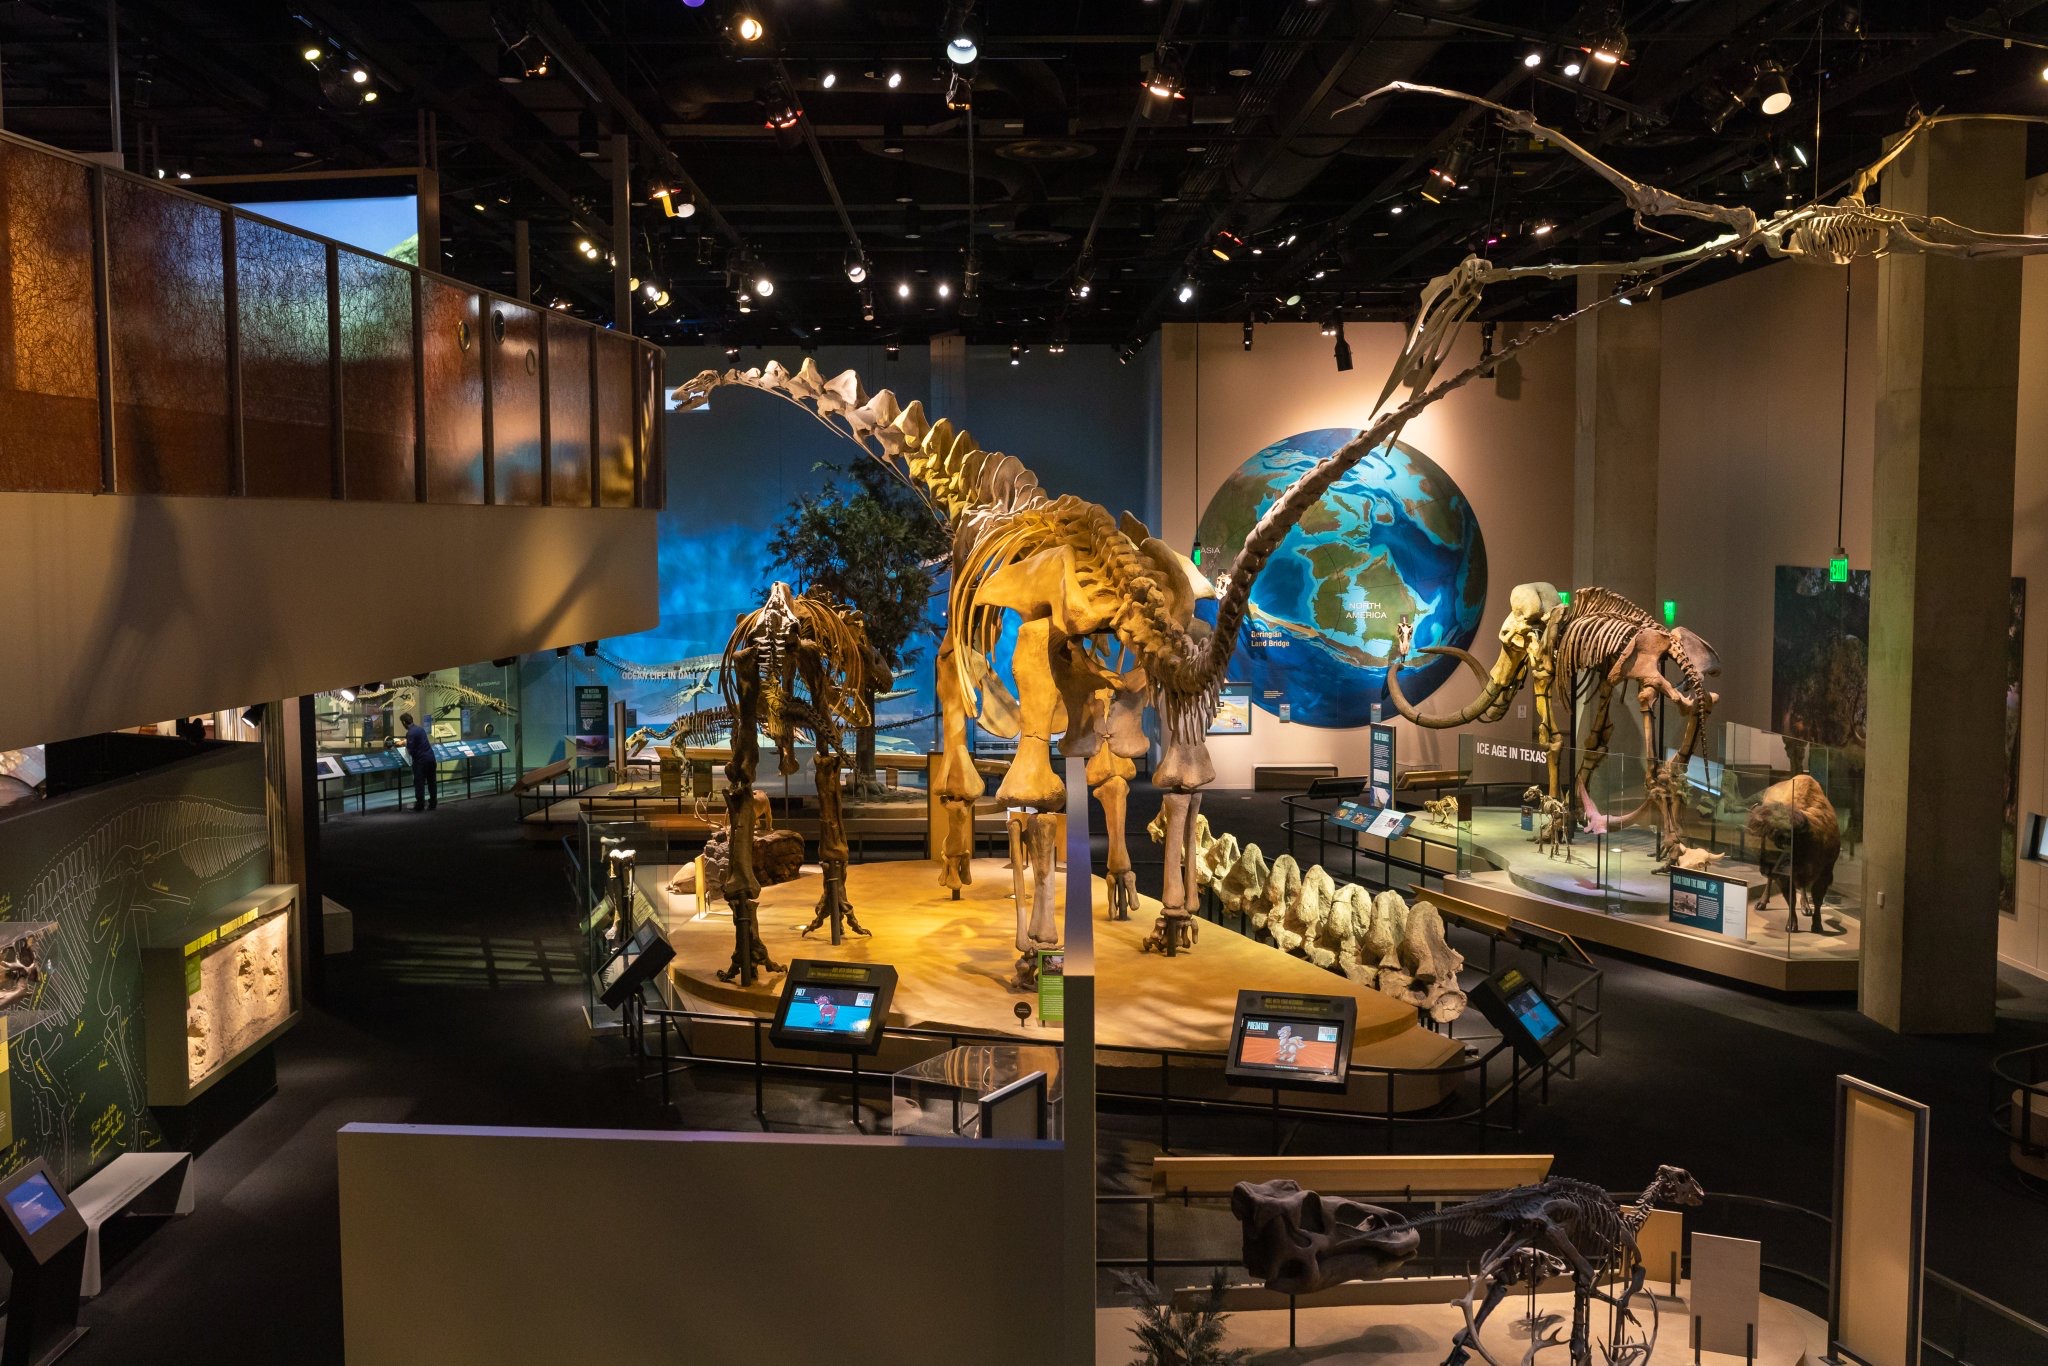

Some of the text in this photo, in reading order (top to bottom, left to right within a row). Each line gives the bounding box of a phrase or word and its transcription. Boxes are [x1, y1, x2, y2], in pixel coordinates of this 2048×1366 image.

[1200, 546, 1221, 554] ASIA
[1832, 560, 1845, 580] EXIT
[1349, 602, 1381, 610] NORTH
[1345, 611, 1388, 619] AMERICA
[1268, 640, 1290, 649] Bridge
[621, 671, 648, 680] OCEAN
[650, 671, 666, 680] LIFE
[667, 671, 676, 680] IN
[1476, 742, 1547, 764] ICE AGE IN TEXAS
